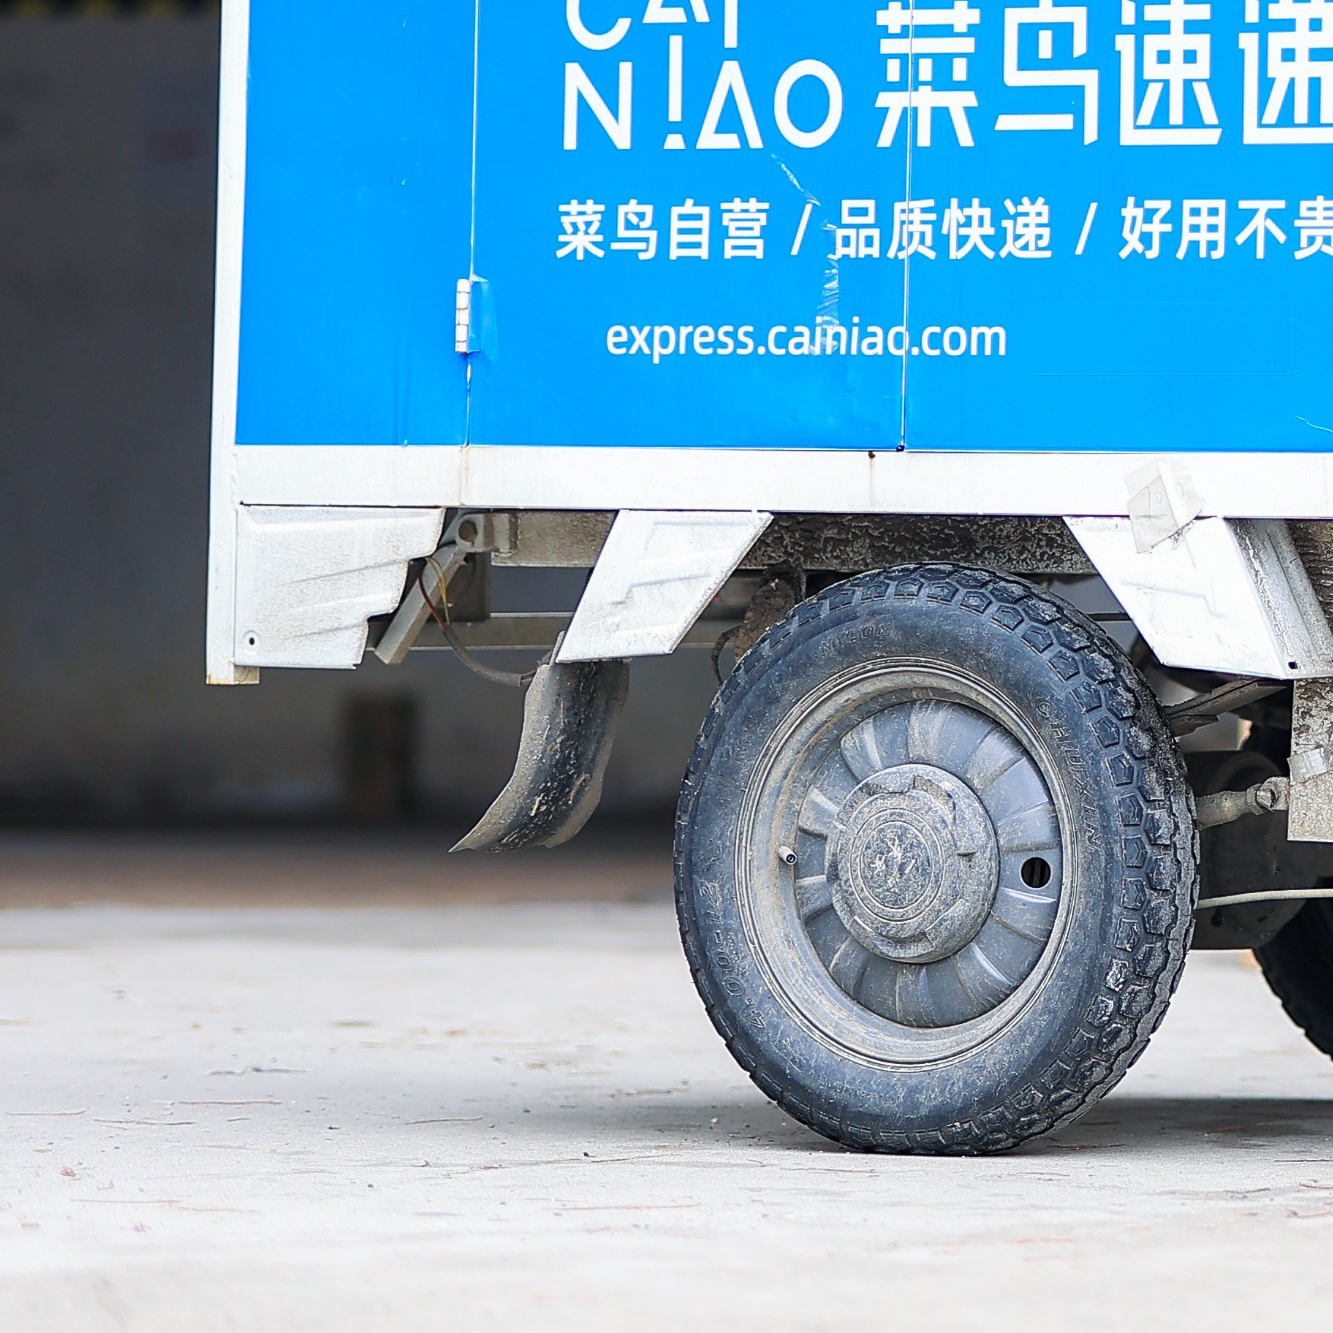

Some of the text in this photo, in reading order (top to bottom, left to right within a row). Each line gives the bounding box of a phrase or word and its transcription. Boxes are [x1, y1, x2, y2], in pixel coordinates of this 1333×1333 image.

[556, 198, 769, 260] 菜鸟自营
[833, 196, 1052, 260] 品质快递
[606, 316, 1007, 364] express.cainiao.com
[818, 621, 895, 658] NYLON
